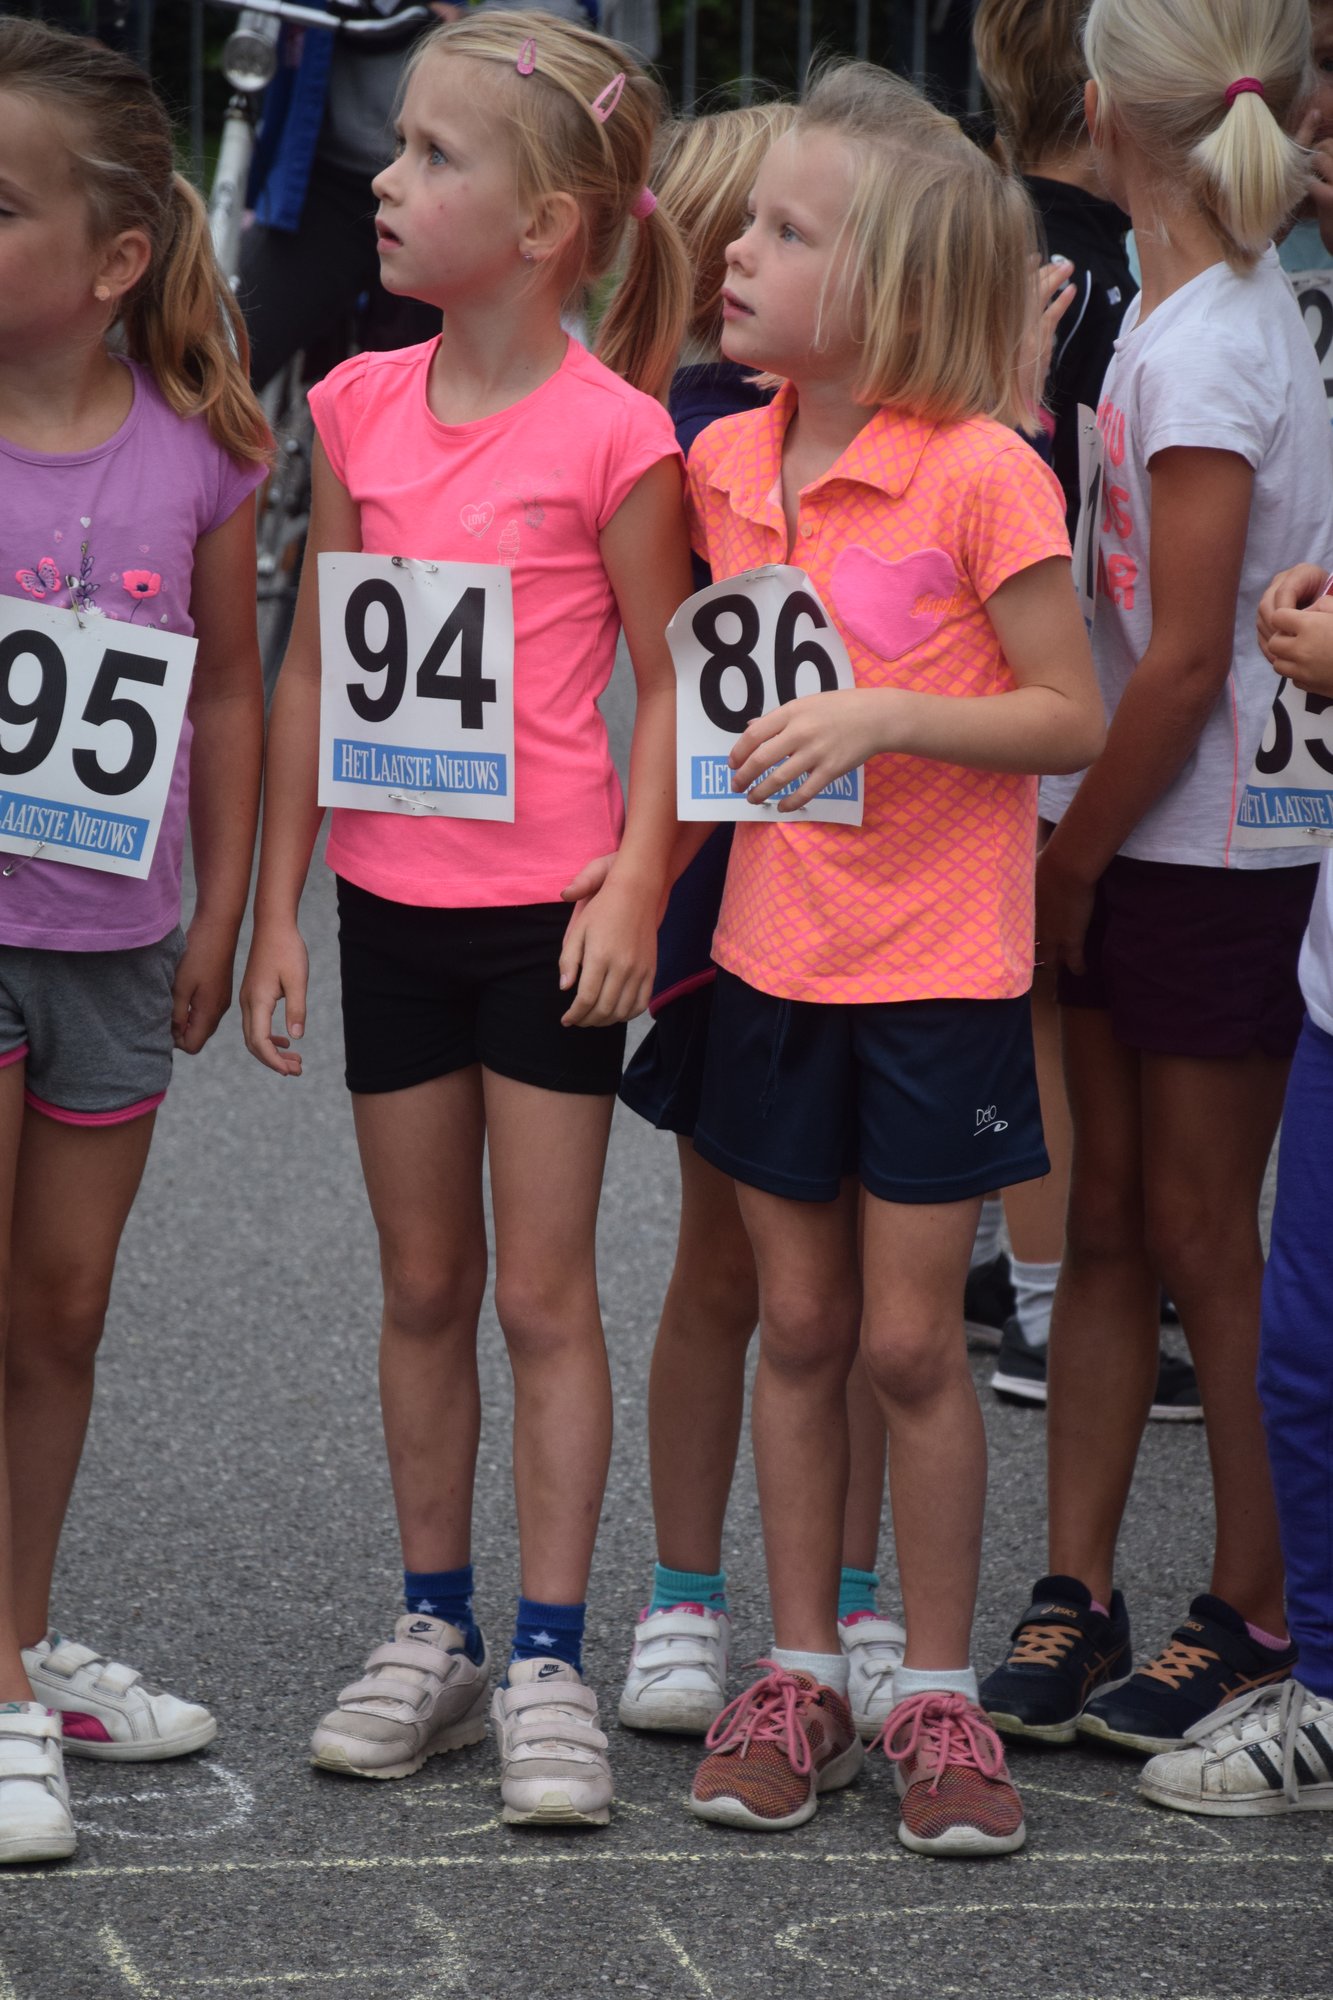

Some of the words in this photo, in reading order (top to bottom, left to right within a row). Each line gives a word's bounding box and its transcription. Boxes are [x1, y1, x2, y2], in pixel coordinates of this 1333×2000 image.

[467, 511, 488, 526] LOVE
[344, 577, 497, 730] 94
[691, 590, 839, 734] 86
[0, 629, 168, 796] 95
[341, 743, 370, 780] HET
[370, 747, 433, 788] LAATSTE
[435, 754, 499, 792] NIEUWS
[0, 794, 69, 840] AATSTE
[66, 809, 138, 855] NIEUWS
[1260, 792, 1330, 825] LAATSTE
